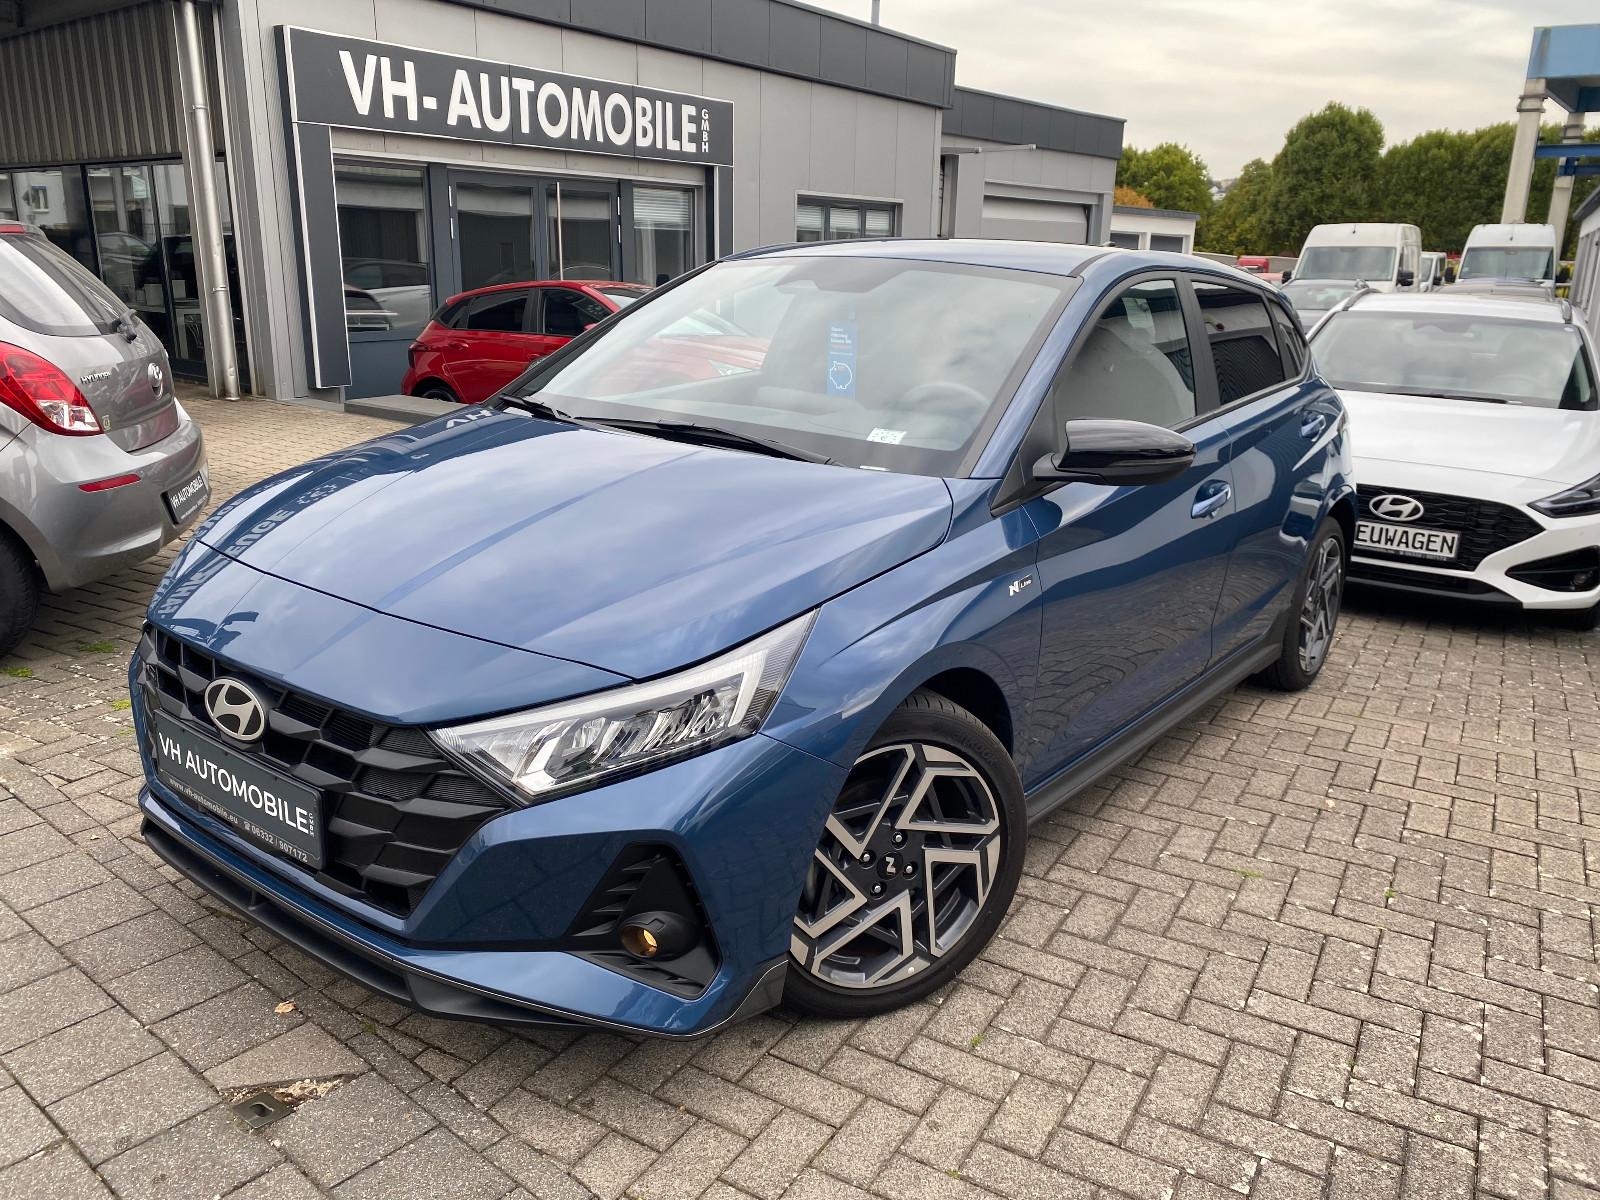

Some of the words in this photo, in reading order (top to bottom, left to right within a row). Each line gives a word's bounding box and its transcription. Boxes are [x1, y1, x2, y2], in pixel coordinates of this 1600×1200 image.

[339, 50, 437, 121] VH-
[446, 69, 697, 153] AUTOMOBILE
[701, 108, 710, 153] GMBH
[1356, 524, 1456, 554] EUWAGEN
[158, 732, 182, 764] VH
[185, 750, 309, 834] AUTOMOBILE
[252, 825, 274, 845] 06332
[279, 840, 308, 863] 907172
